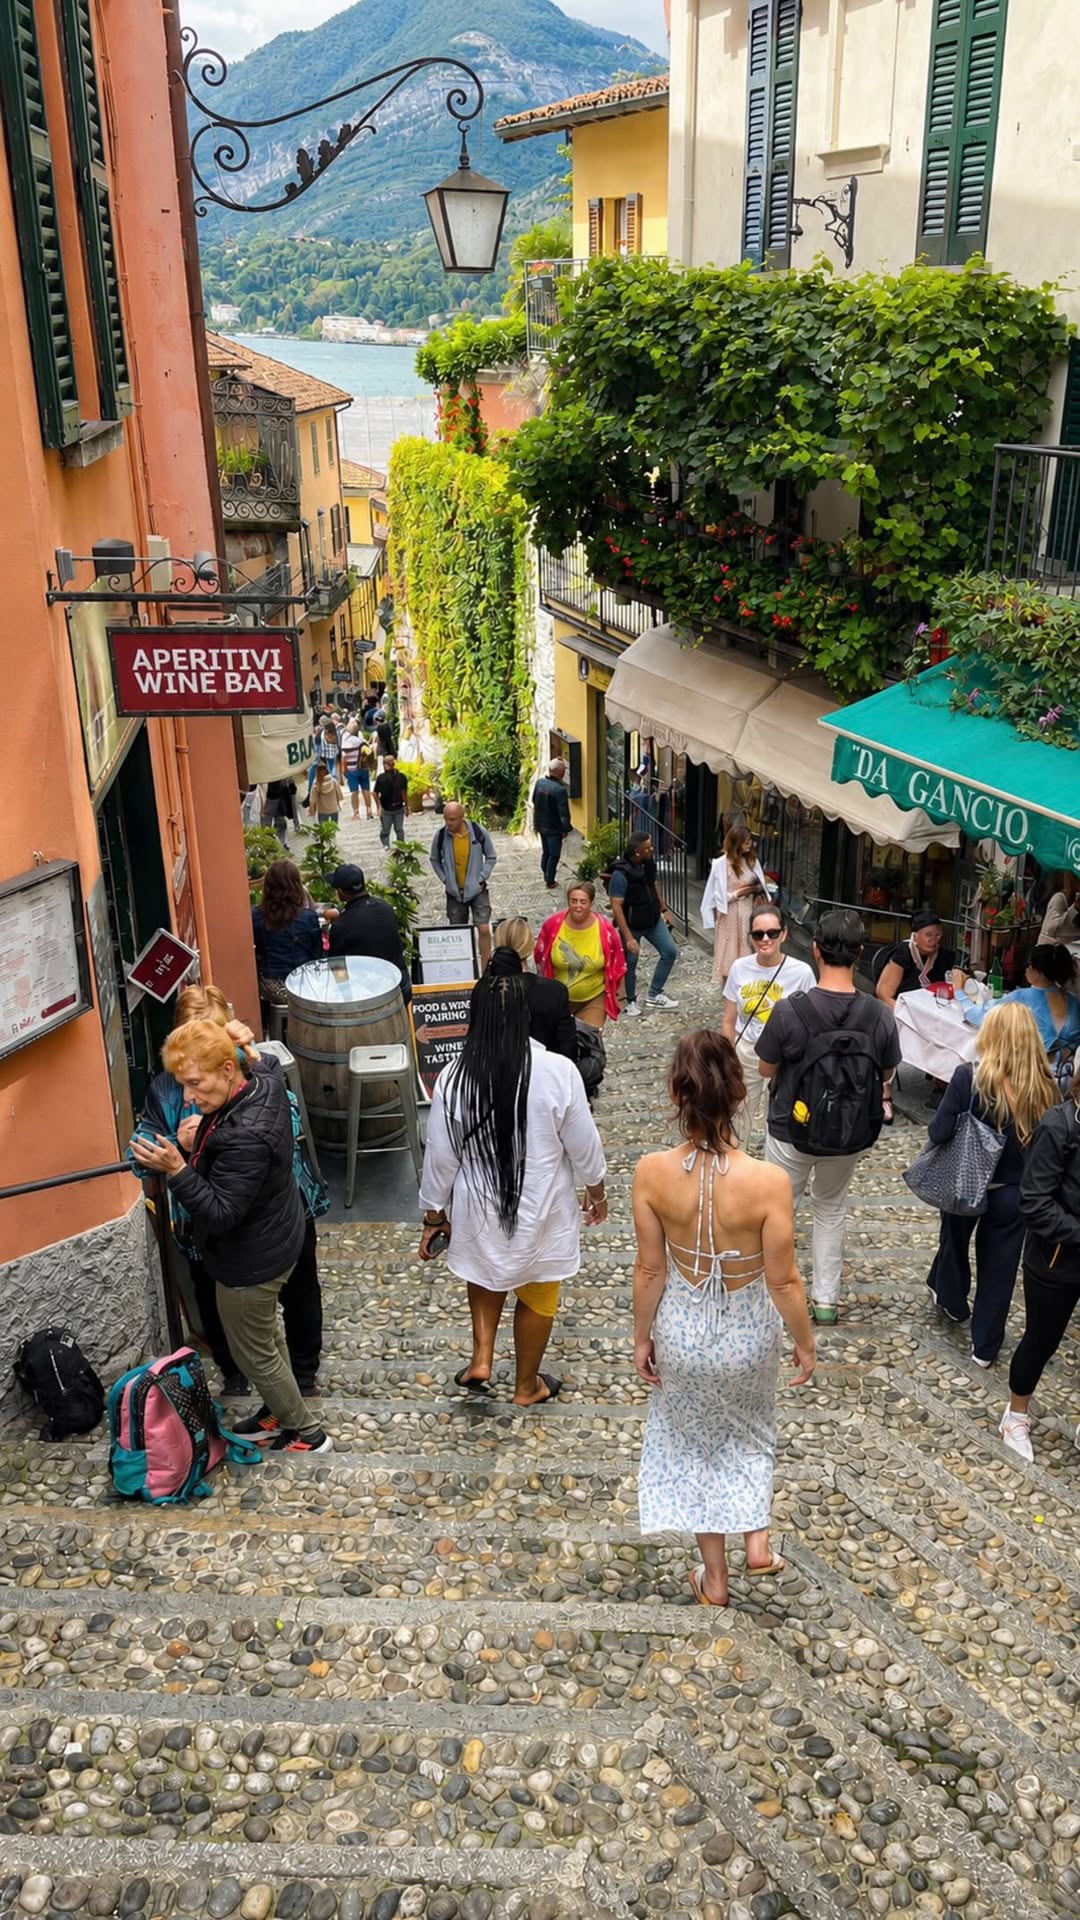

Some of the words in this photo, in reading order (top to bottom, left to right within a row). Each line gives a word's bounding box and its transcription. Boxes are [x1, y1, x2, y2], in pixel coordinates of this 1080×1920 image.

[132, 648, 283, 671] APERITIVI
[134, 672, 217, 694] WINE
[224, 672, 284, 693] BAR
[286, 734, 314, 766] BA
[413, 1002, 440, 1014] FOOD
[441, 1002, 448, 1011] &
[448, 1000, 471, 1010] WINE
[424, 1010, 467, 1023] PAIRING
[434, 1041, 464, 1053] WINE
